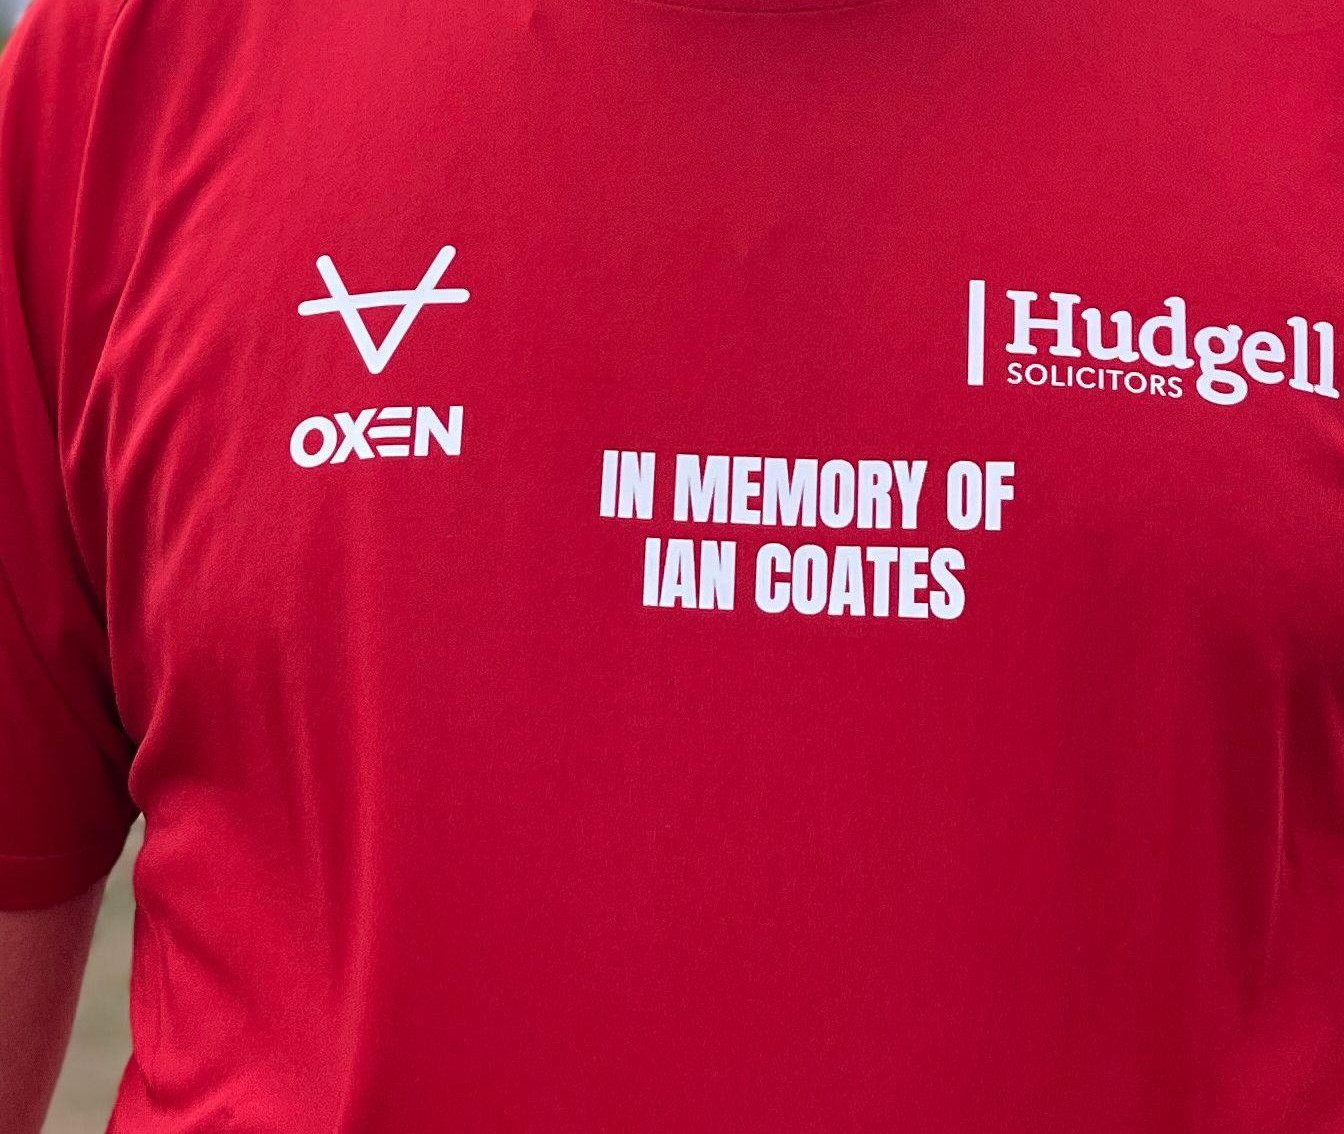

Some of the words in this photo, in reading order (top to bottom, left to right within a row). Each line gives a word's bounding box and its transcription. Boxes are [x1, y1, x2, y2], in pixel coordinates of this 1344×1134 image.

[1005, 289, 1340, 406] Hudgell
[1007, 362, 1183, 399] SOLICITORS
[289, 405, 464, 468] OXEN
[599, 449, 656, 520] IN
[673, 453, 928, 530] MEMORY
[946, 460, 1015, 531] OF
[642, 537, 737, 611] IAN
[754, 542, 966, 620] COATES
